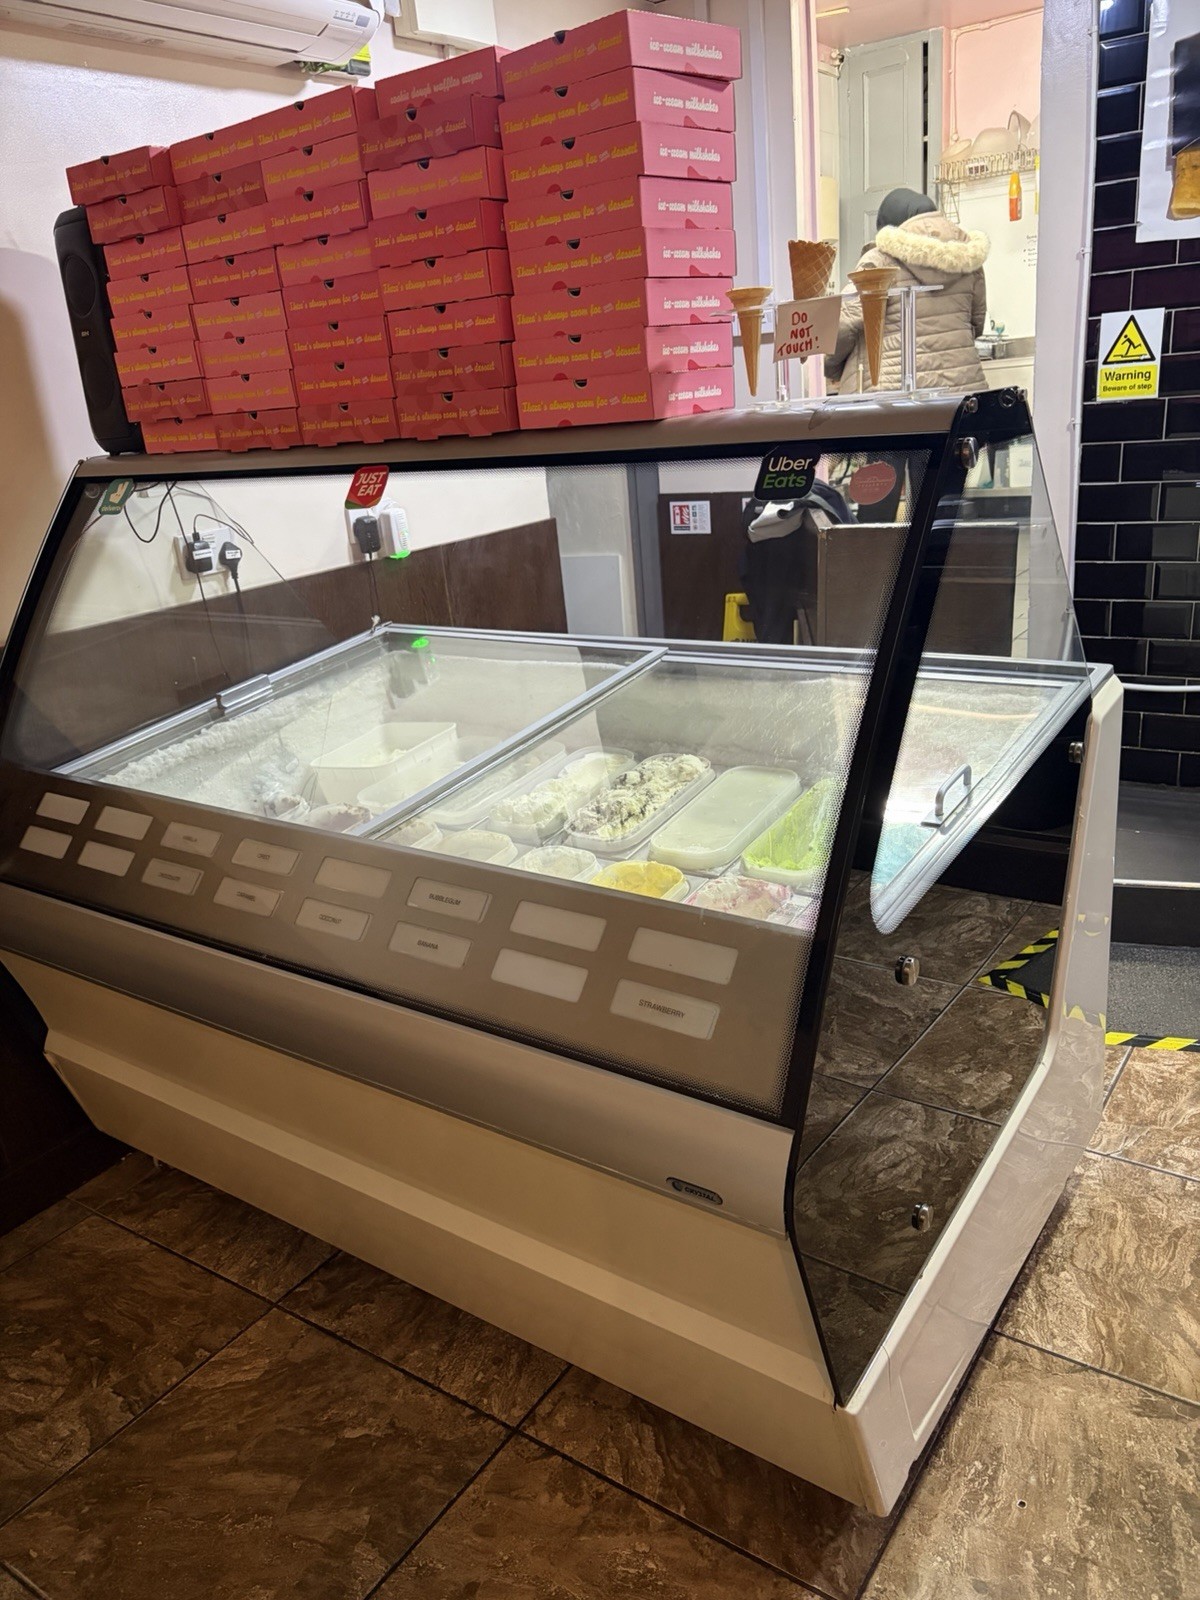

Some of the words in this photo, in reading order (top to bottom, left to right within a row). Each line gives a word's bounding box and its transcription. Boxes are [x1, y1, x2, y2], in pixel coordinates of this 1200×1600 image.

[531, 112, 556, 127] always
[602, 90, 628, 106] dessert
[538, 161, 563, 176] always
[611, 142, 638, 158] dessert
[536, 215, 561, 227] always
[608, 196, 634, 212] dessert
[543, 261, 569, 274] always
[615, 245, 642, 260] dessert
[543, 310, 568, 322] always
[615, 297, 641, 311] dessert
[792, 311, 808, 326] DO
[790, 324, 814, 340] NOT
[545, 353, 570, 365] always
[615, 344, 641, 357] dessert
[777, 336, 820, 356] TOUCH!
[1104, 370, 1151, 382] Warning
[1138, 383, 1152, 391] step
[549, 400, 575, 411] always
[621, 392, 648, 404] dessert
[768, 456, 813, 472] Uber
[355, 471, 387, 487] JUST
[762, 473, 807, 489] Eats
[357, 484, 383, 497] EAT
[638, 999, 686, 1018] STRAWBERRY
